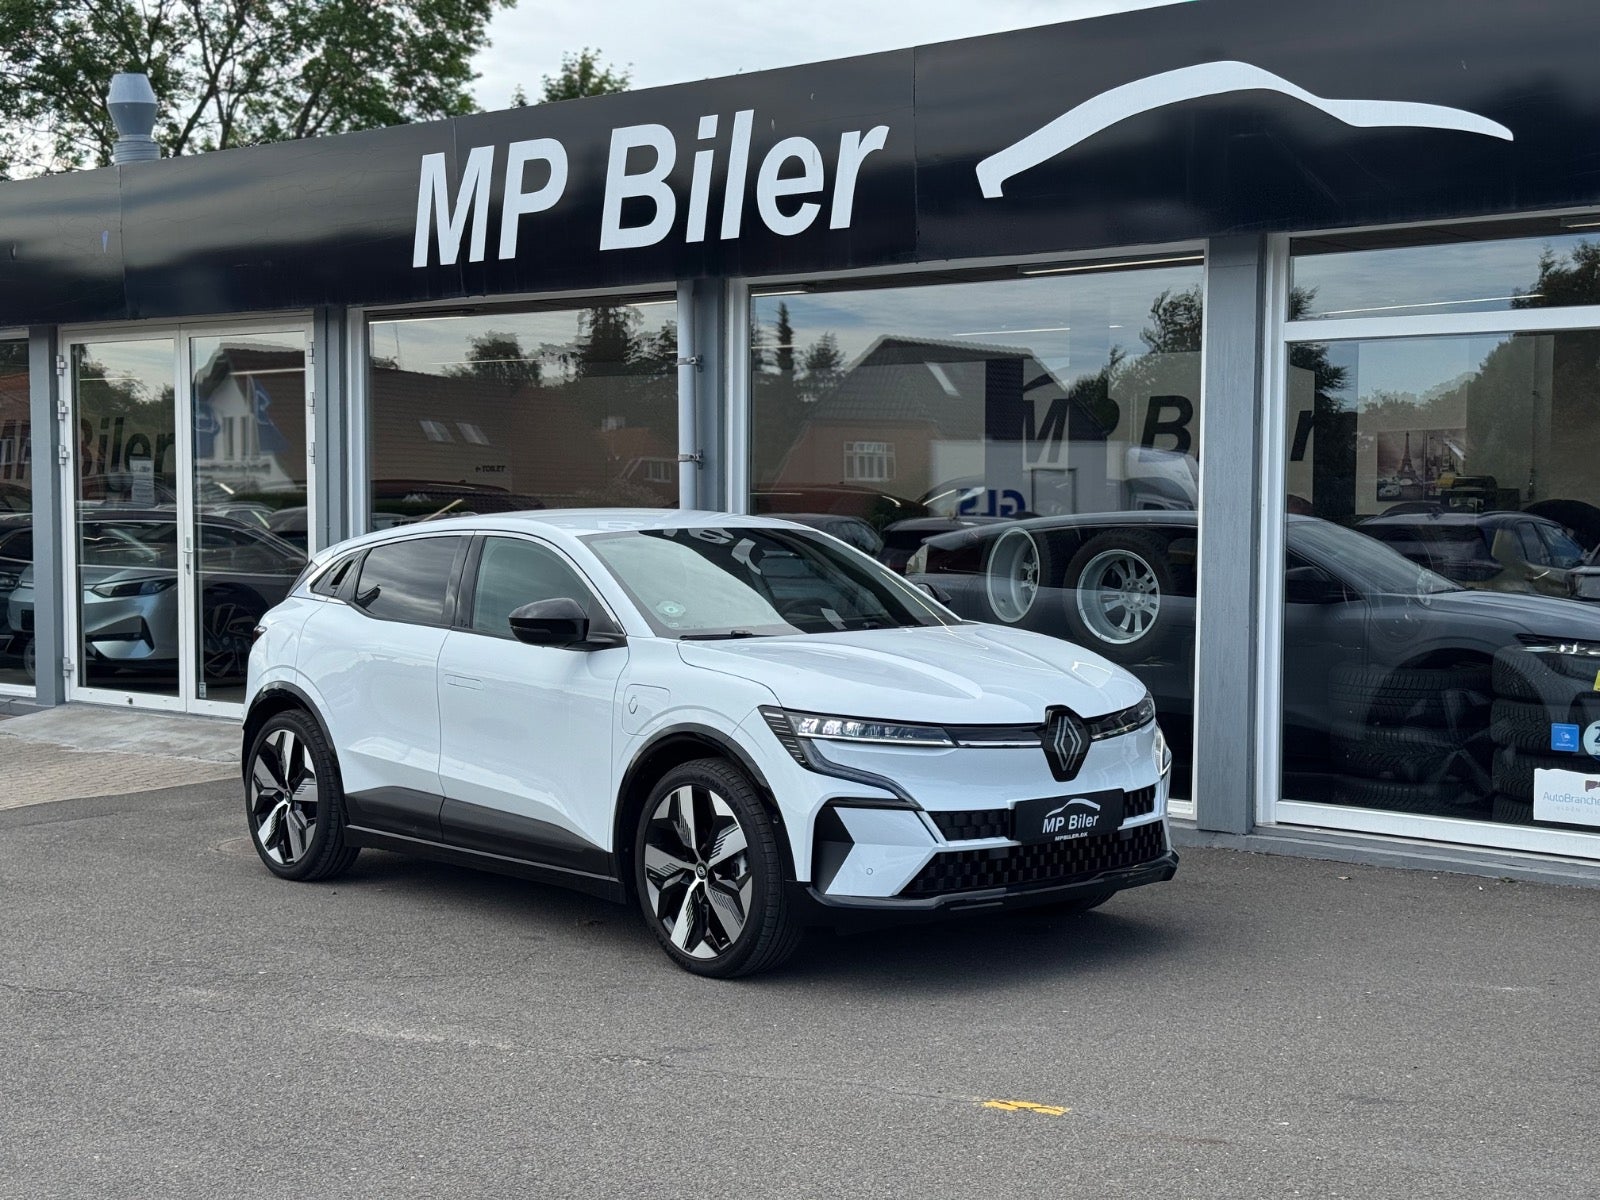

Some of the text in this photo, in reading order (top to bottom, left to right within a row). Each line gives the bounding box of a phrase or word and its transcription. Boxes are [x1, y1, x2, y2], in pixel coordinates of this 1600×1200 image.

[413, 109, 889, 268] MP Biler
[1042, 813, 1099, 833] MP Biler
